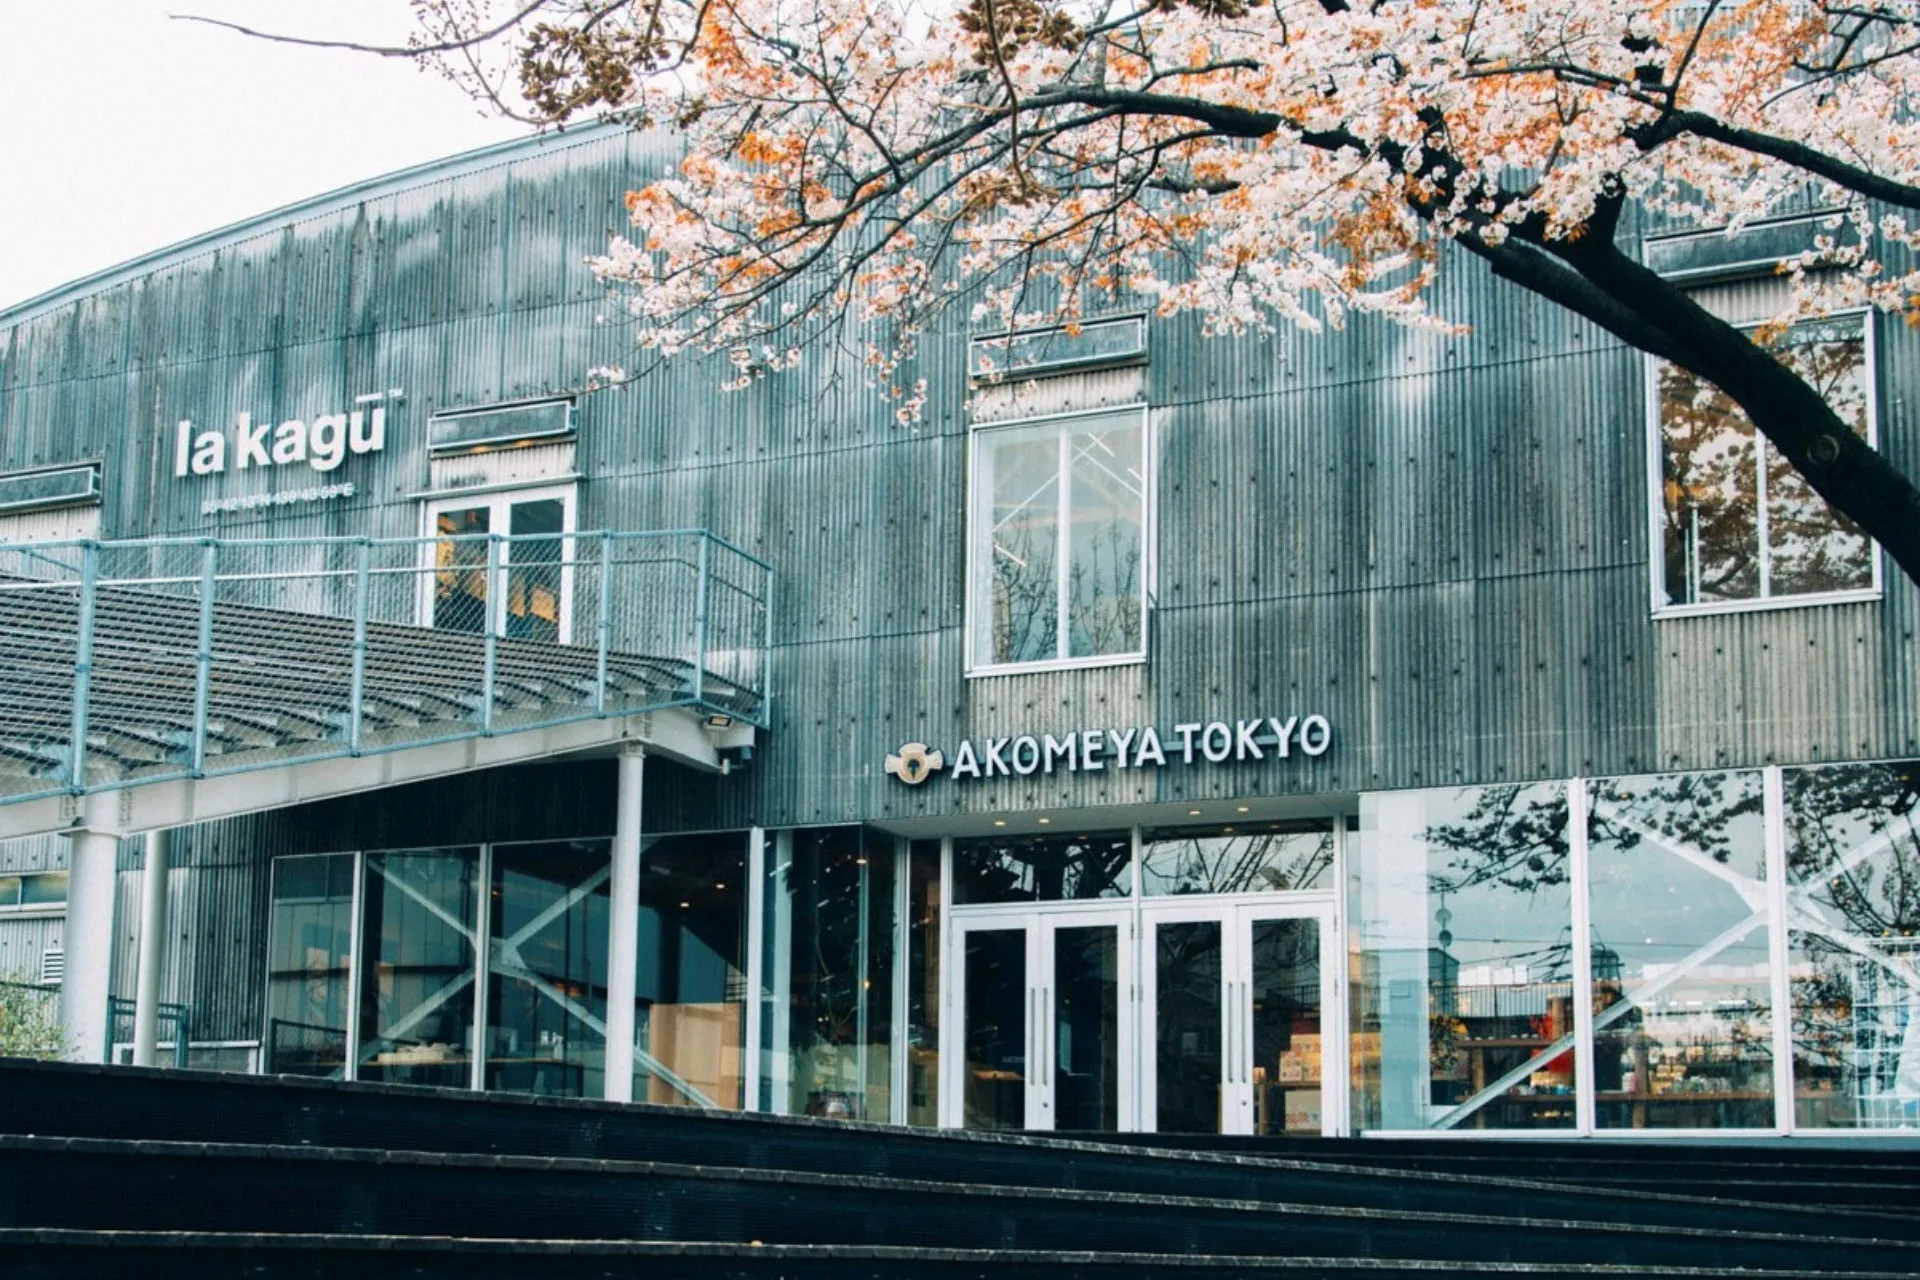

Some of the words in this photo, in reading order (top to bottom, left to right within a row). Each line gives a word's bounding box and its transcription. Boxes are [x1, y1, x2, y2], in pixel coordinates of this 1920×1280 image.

[175, 420, 225, 477] la
[951, 725, 1167, 780] AKOMEYA
[1175, 713, 1331, 764] TOKYO
